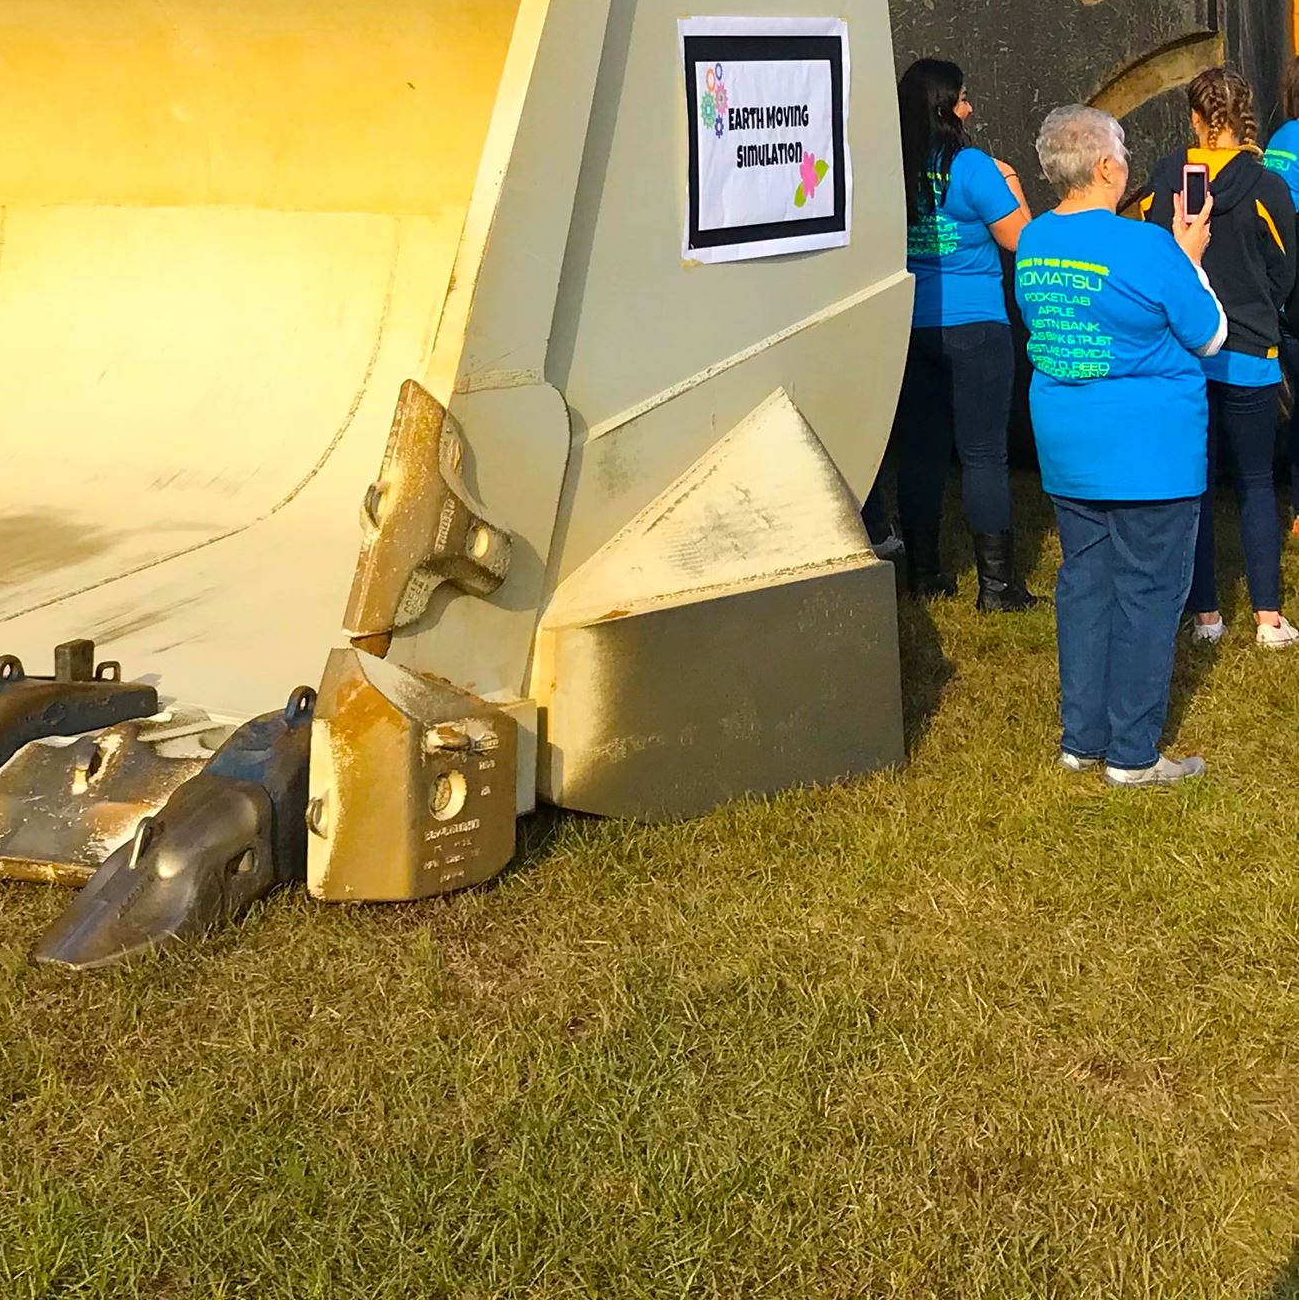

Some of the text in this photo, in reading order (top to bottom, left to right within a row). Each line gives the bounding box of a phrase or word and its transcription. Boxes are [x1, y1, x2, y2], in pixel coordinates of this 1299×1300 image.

[728, 104, 809, 131] EARTH MOVING
[737, 141, 802, 168] SIMULATION
[1038, 305, 1075, 318] APPLE
[1061, 320, 1101, 332] BANK
[1076, 334, 1114, 346] TRUST
[1061, 347, 1116, 360] CHEMICAL
[1071, 361, 1111, 372] REED
